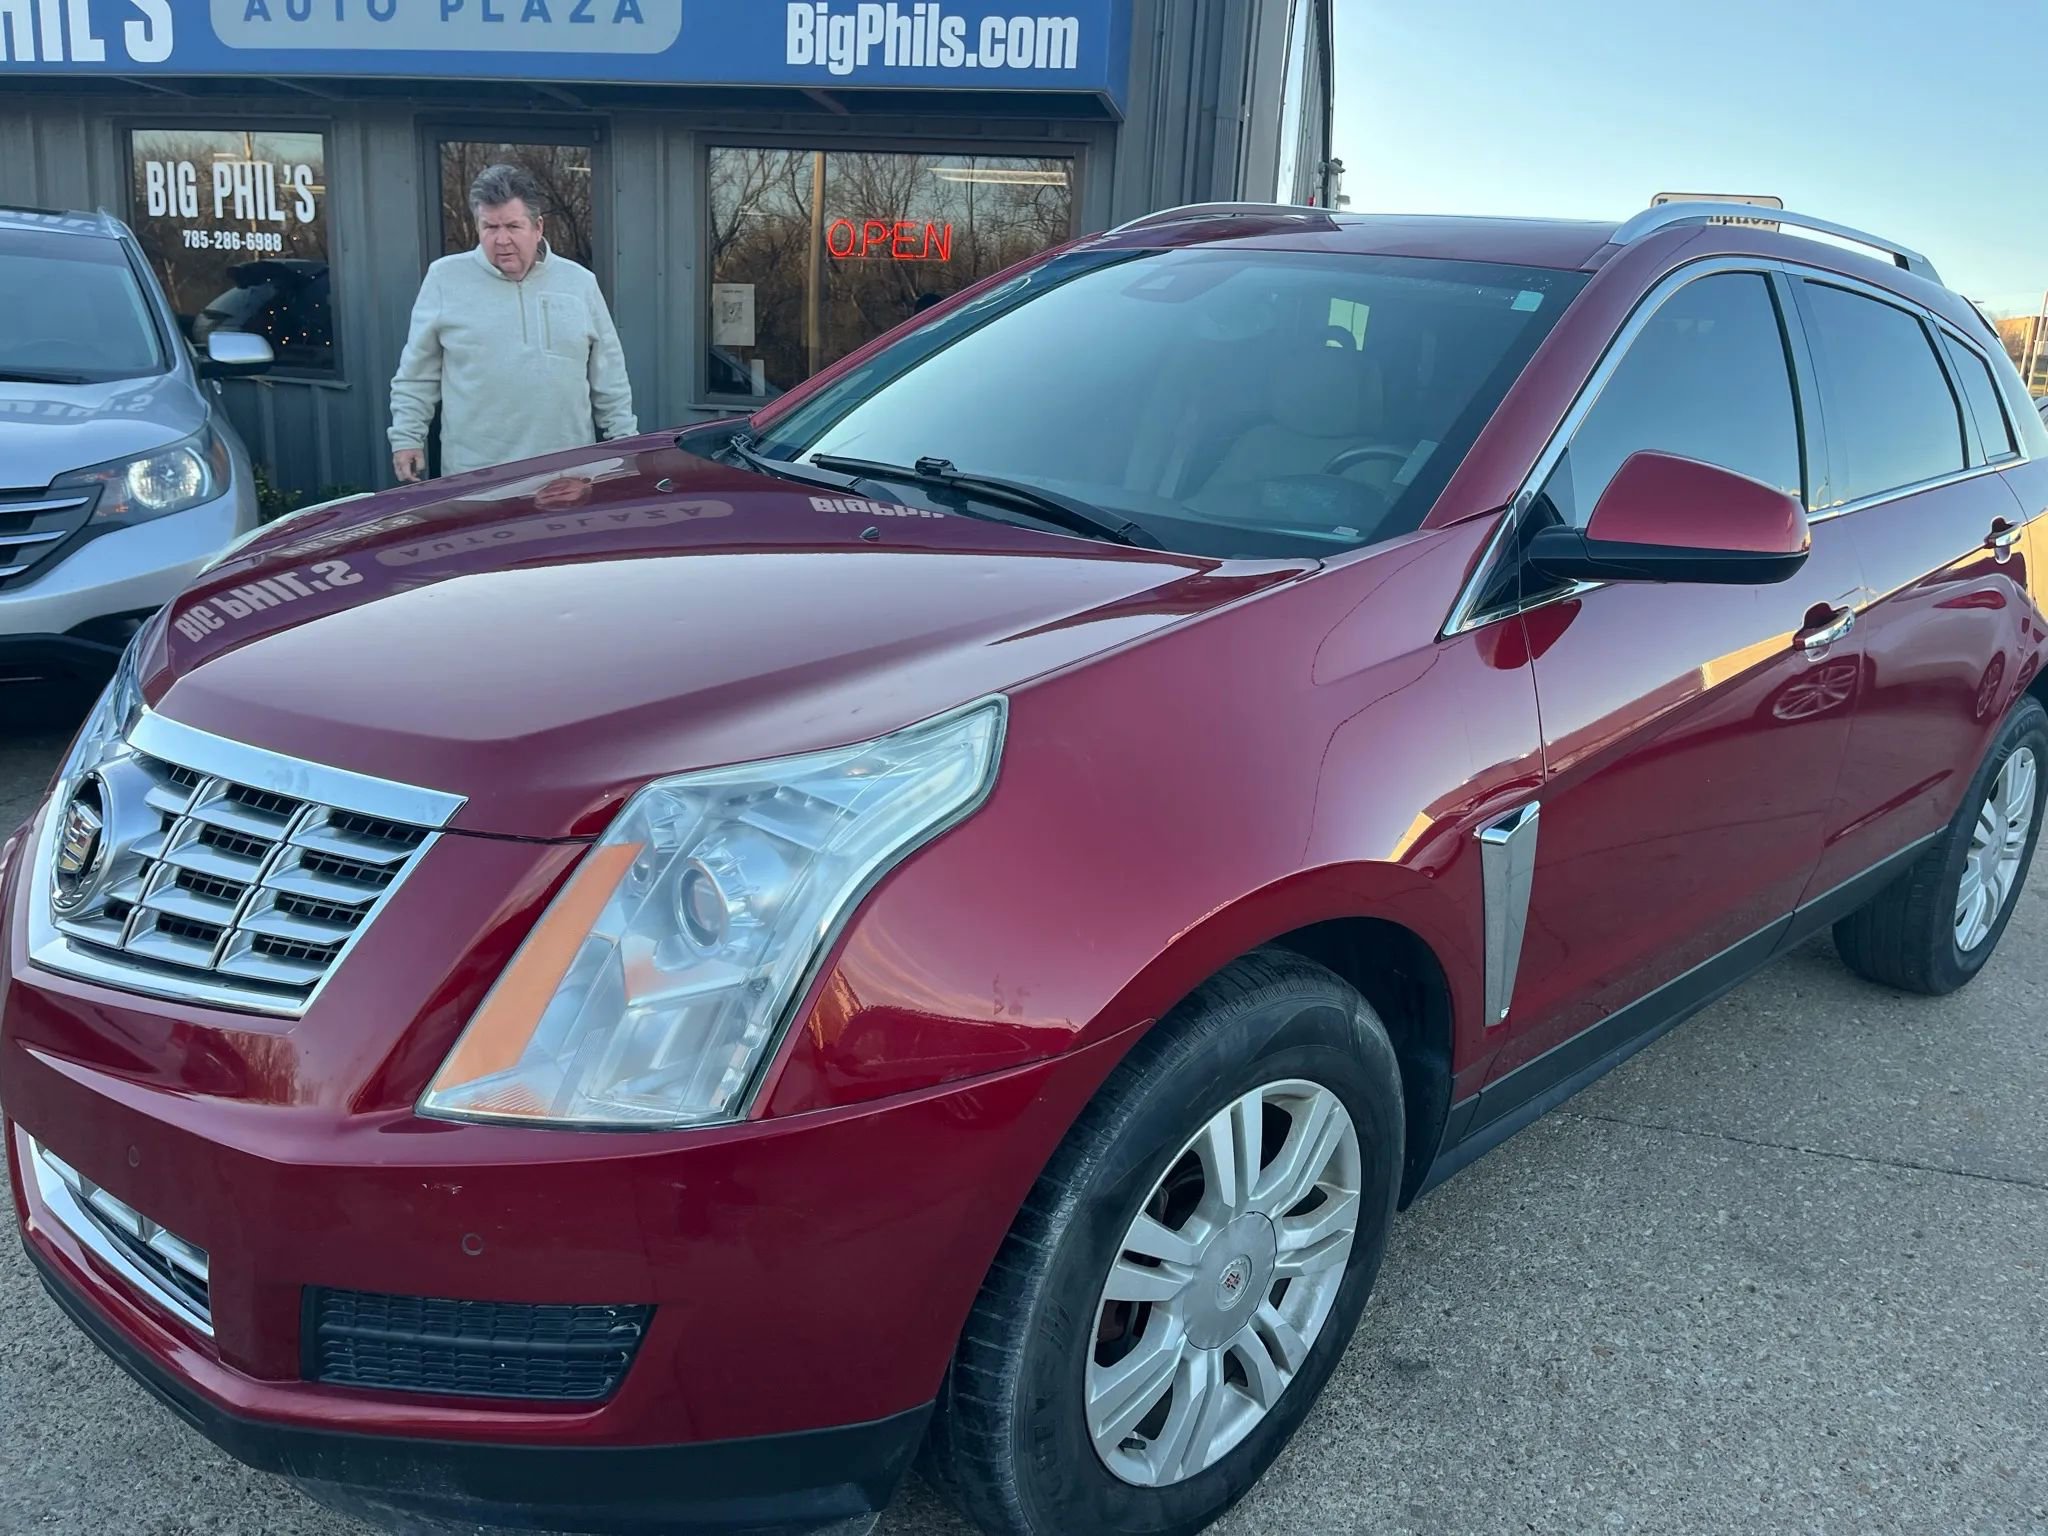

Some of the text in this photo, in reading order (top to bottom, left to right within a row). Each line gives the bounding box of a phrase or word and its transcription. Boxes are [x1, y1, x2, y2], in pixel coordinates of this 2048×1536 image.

[440, 0, 645, 24] PLAZA
[786, 2, 1080, 75] BigPhils.com
[145, 160, 316, 223] BIG PHIL'S
[182, 229, 283, 252] 785-286-6988
[826, 218, 953, 262] OPEN
